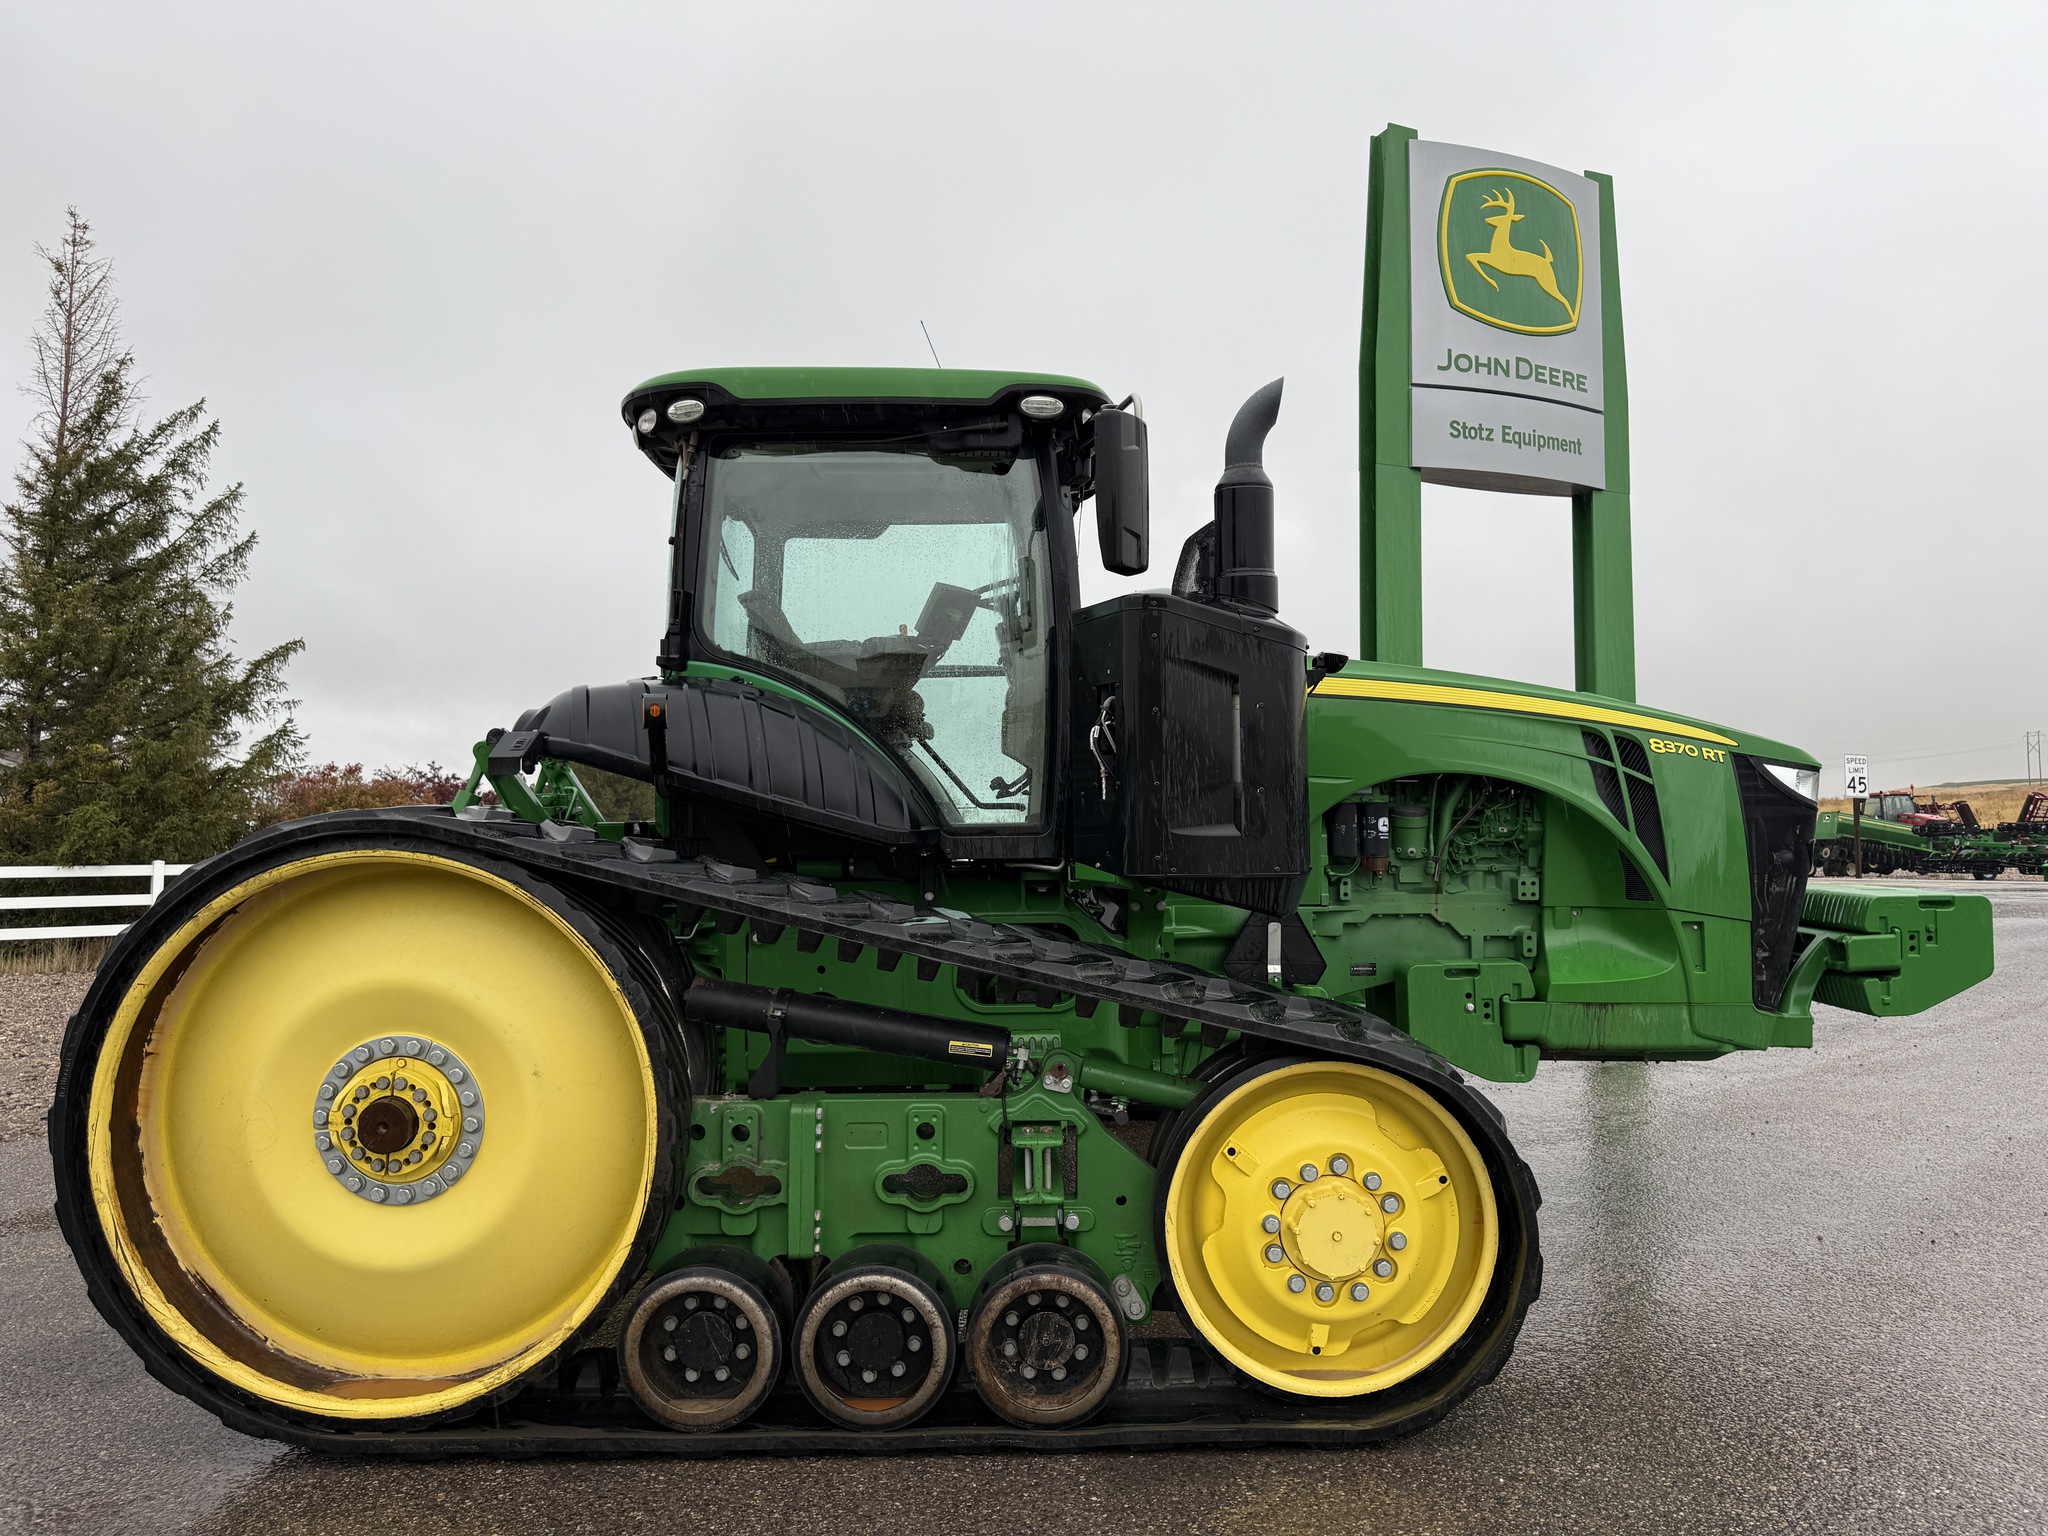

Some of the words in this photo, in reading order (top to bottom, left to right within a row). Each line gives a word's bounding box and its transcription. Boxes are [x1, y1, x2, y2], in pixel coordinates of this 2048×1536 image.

[1437, 348, 1510, 378] JOHN
[1515, 356, 1588, 393] DEERE
[1449, 419, 1494, 441] Stotz
[1501, 425, 1582, 455] Equipment
[1649, 737, 1699, 758] 8370
[1701, 747, 1726, 764] RT
[1846, 757, 1867, 765] SPEED
[1847, 776, 1867, 793] 45
